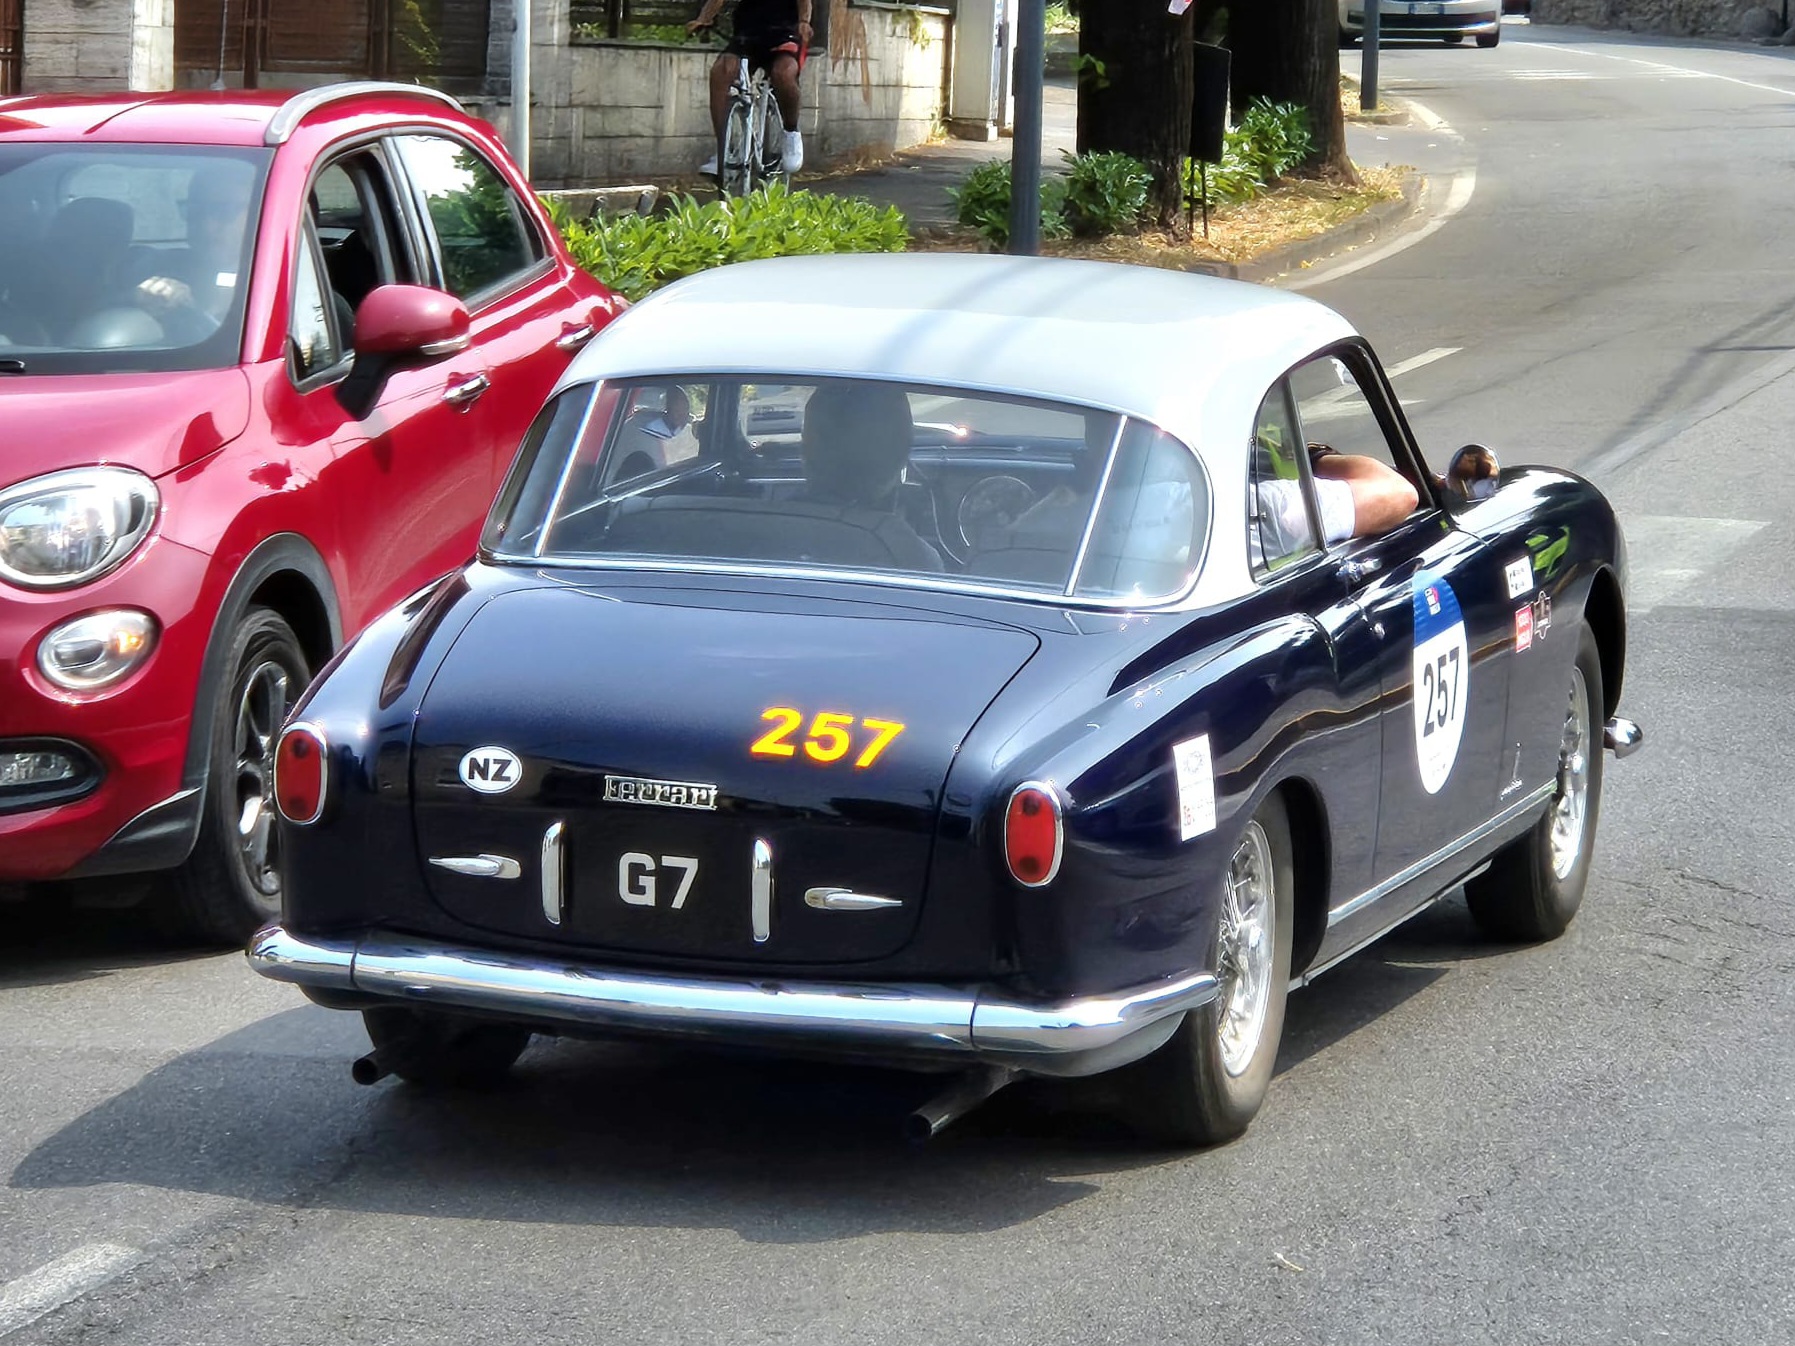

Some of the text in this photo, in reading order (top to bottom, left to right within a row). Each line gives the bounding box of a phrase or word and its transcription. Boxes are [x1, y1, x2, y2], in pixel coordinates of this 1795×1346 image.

[1424, 646, 1459, 737] 257
[750, 706, 905, 768] 257
[468, 757, 512, 783] NZ
[603, 775, 718, 810] Ferrari
[618, 852, 699, 910] G7
